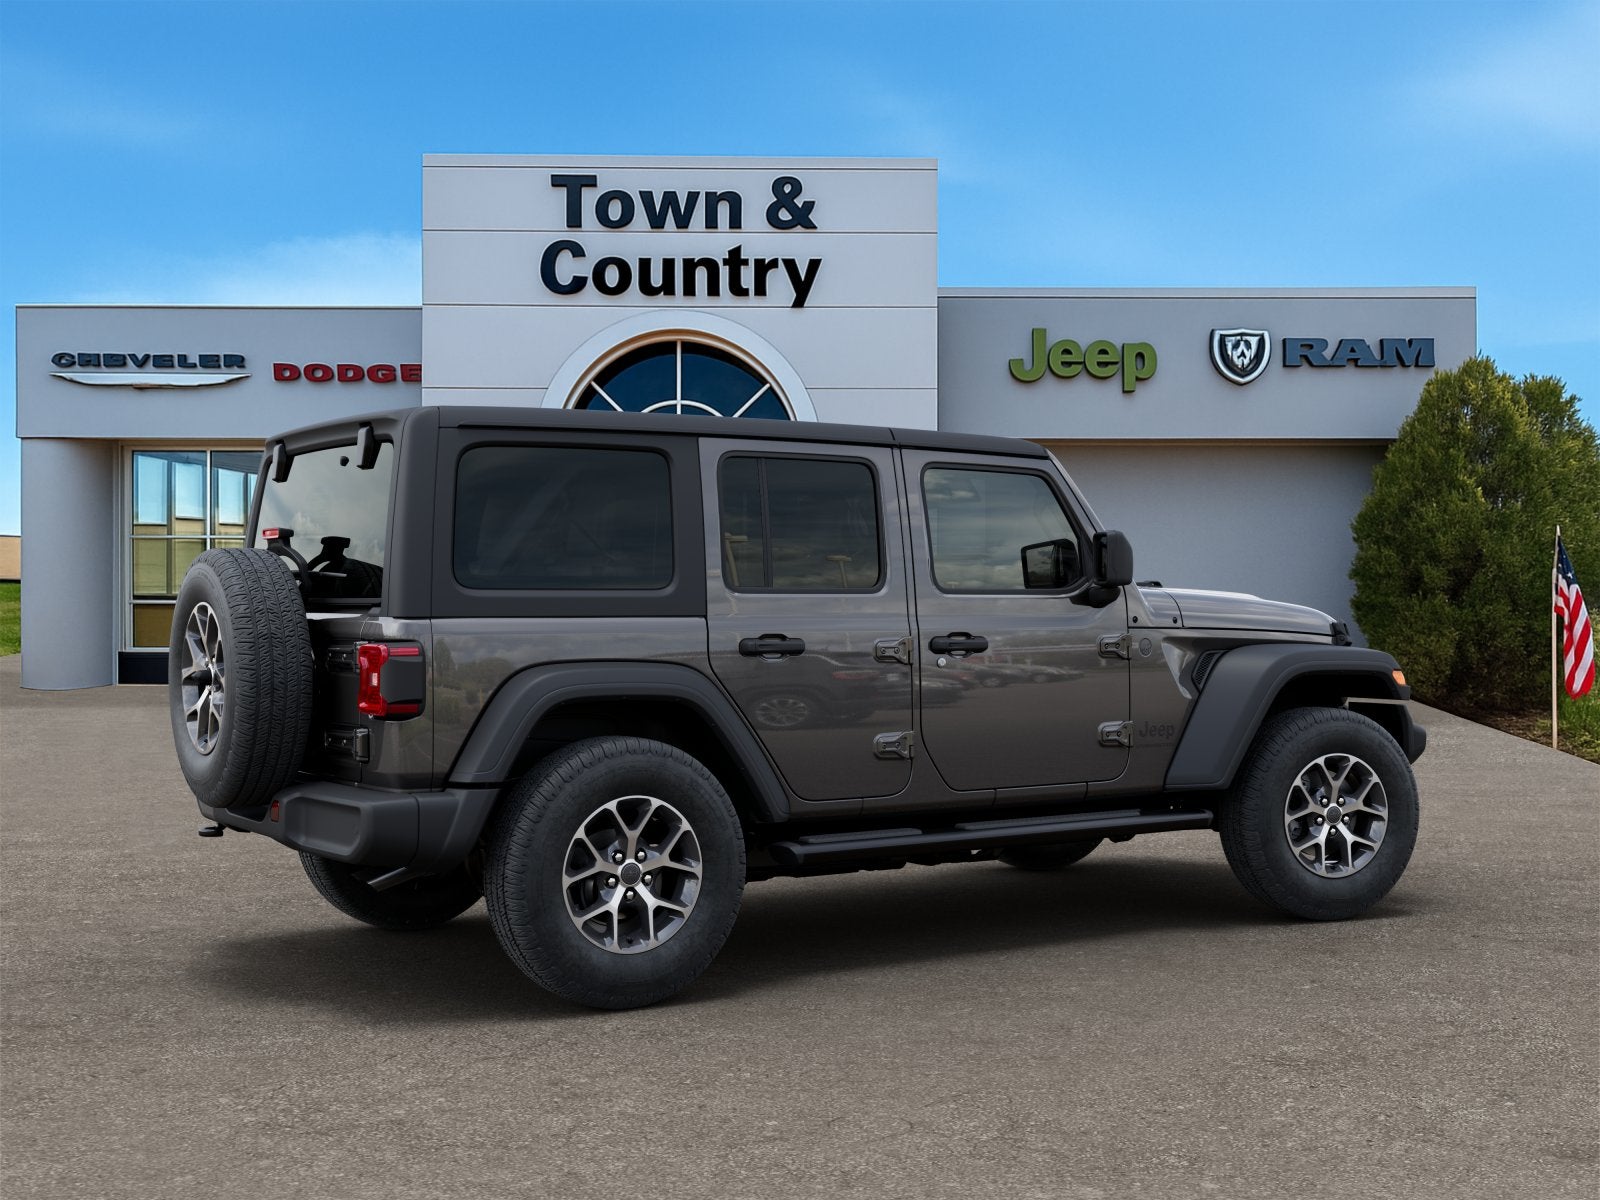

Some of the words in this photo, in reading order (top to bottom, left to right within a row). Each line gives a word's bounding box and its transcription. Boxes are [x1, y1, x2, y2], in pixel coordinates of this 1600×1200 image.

[550, 174, 743, 230] Town
[765, 175, 818, 230] &
[540, 239, 823, 309] Country
[272, 362, 422, 384] DODGE
[1009, 327, 1158, 393] Jeep
[1282, 337, 1436, 368] RAM
[1138, 720, 1175, 739] Jeep
